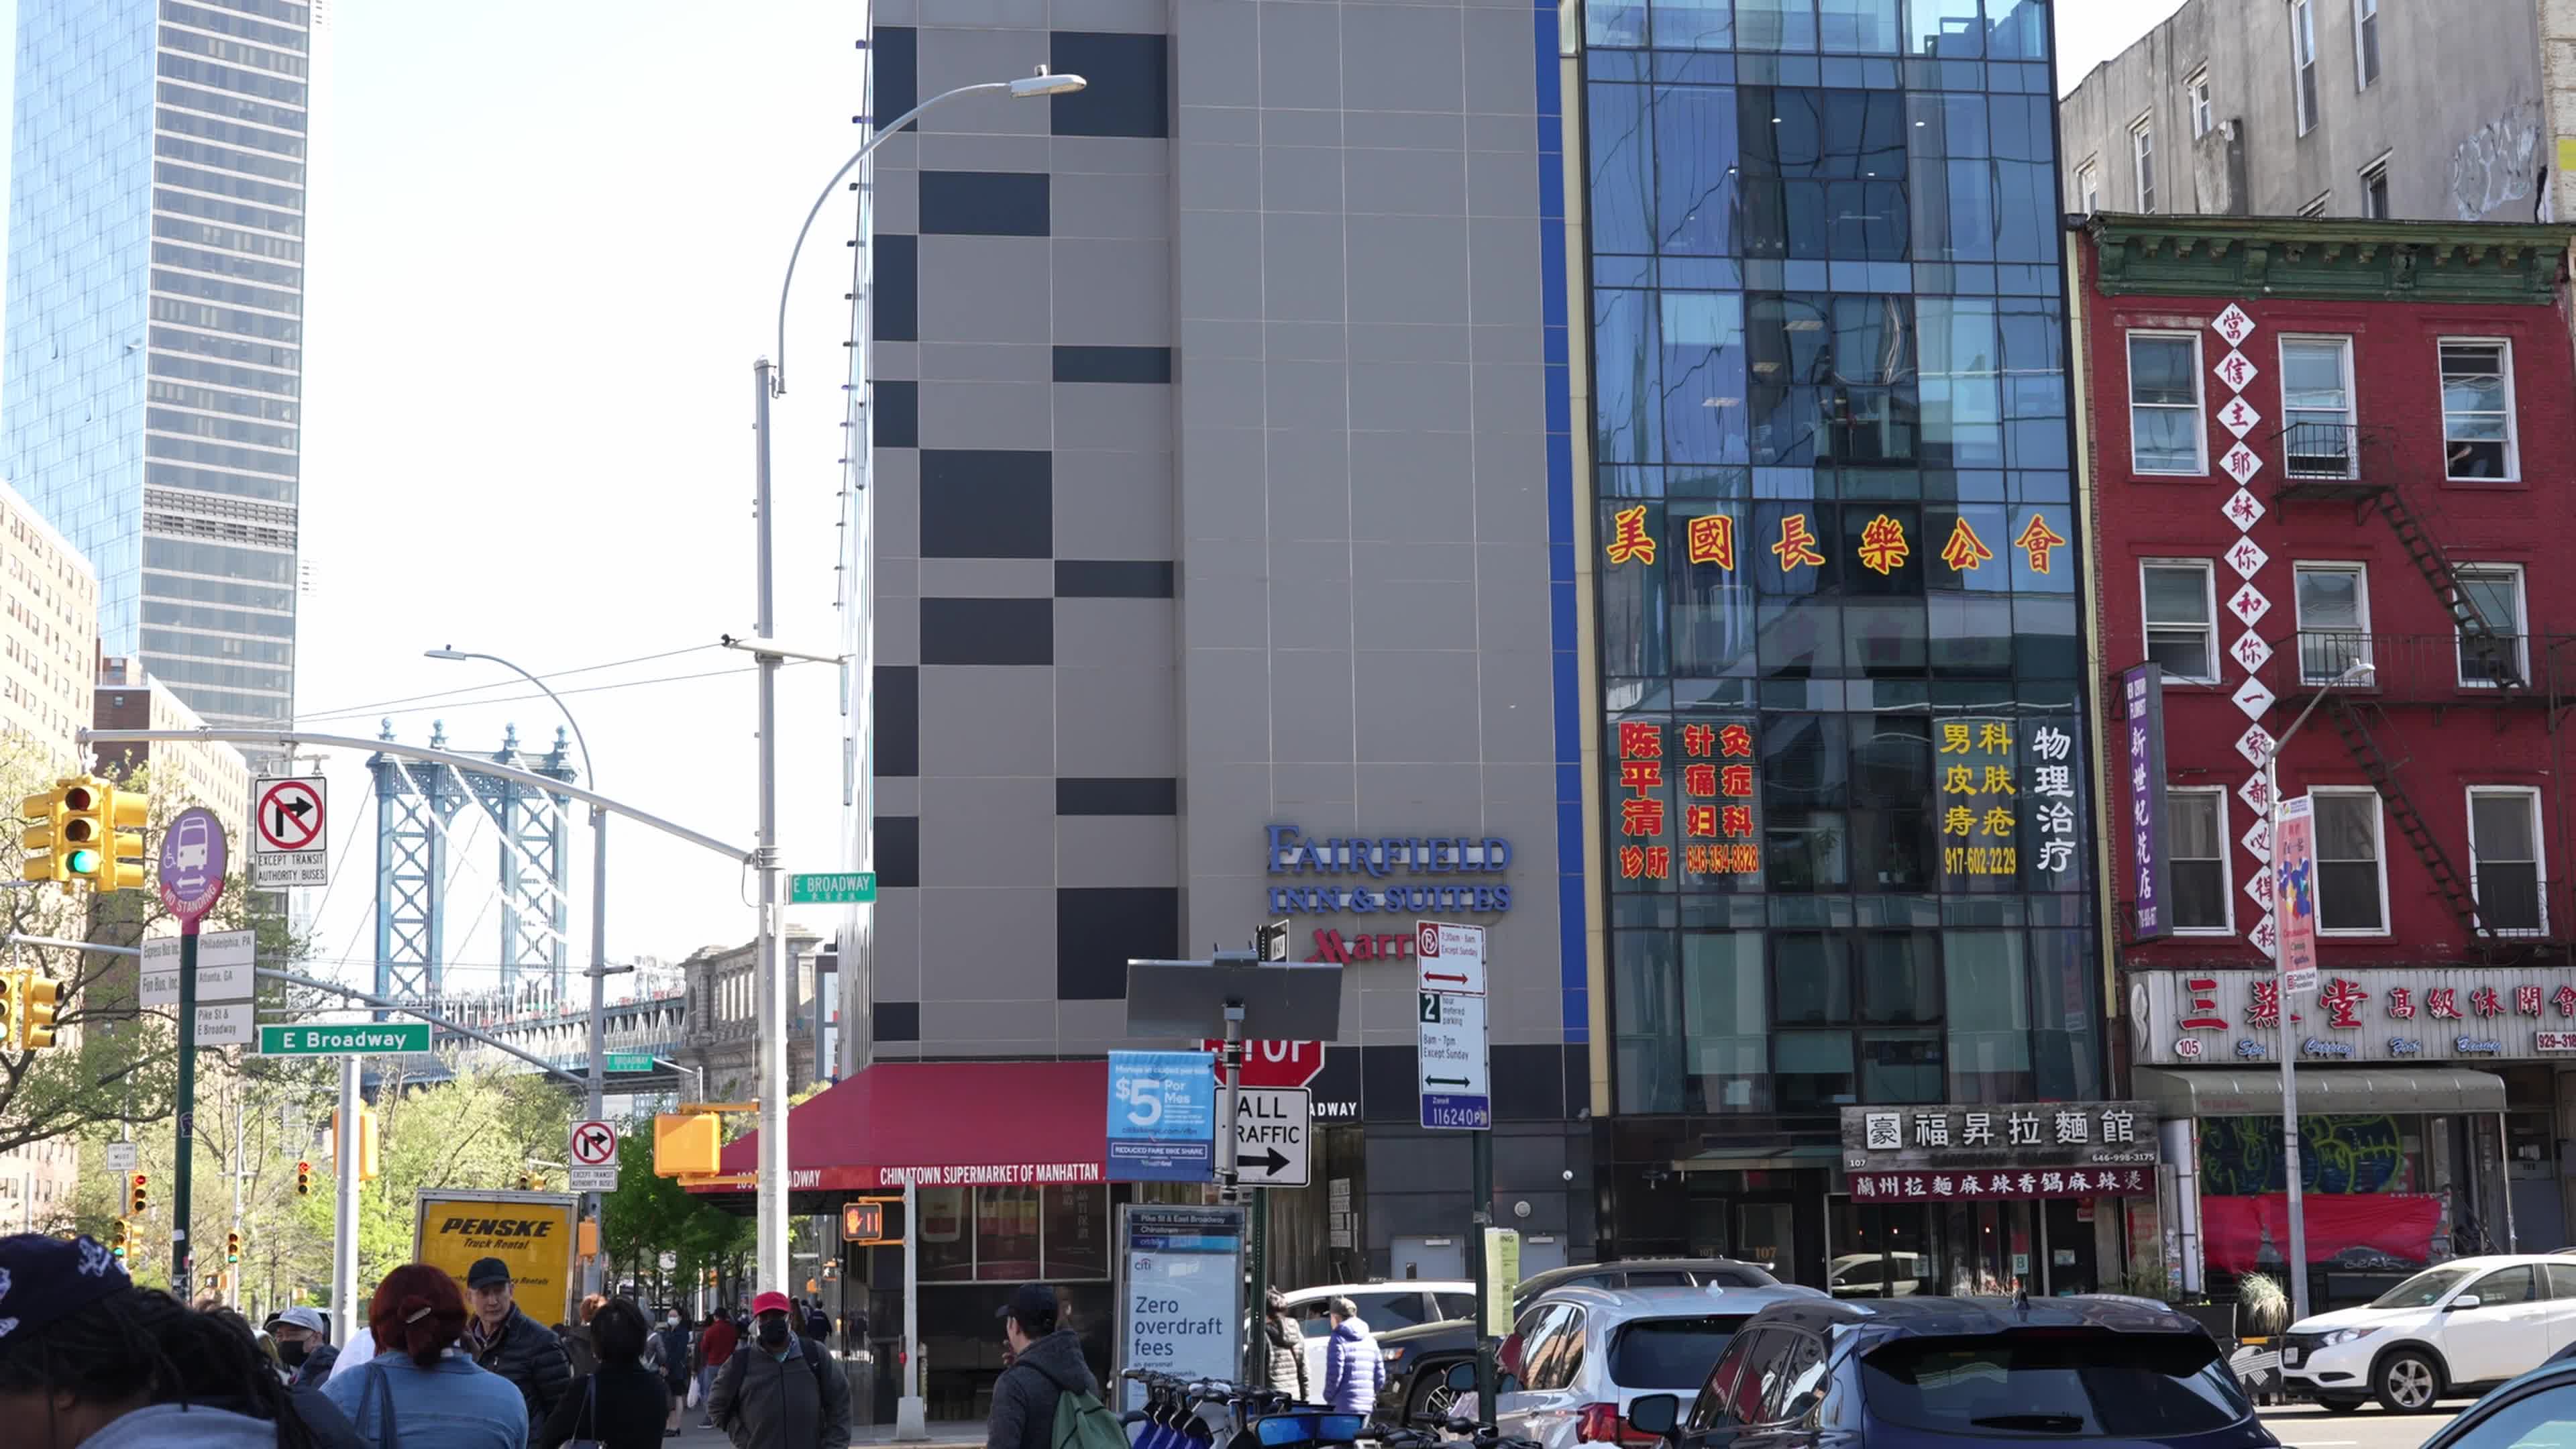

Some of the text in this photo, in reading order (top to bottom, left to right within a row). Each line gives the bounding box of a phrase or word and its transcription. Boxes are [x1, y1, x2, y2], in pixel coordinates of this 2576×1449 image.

[1606, 505, 2065, 575] 美國長樂公會
[1684, 724, 1752, 757] 针灸
[1940, 722, 2013, 755] 男科
[1685, 763, 1754, 796] 痛症
[1943, 763, 2017, 796] 皮肤
[2032, 726, 2076, 873] 物理治疗
[1686, 804, 1754, 837] 妇科
[258, 853, 323, 866] EXCEPT TRANSIT
[1620, 845, 1670, 879] 诊所
[1686, 844, 1760, 873] 646-354-8828
[1945, 847, 2017, 875] 917-602-2229
[258, 869, 325, 881] AUTHORITY BUSES
[794, 875, 870, 893] E BROADWAY
[164, 883, 217, 913] NO STANDING
[1267, 885, 1513, 914] INN & SUITES
[242, 935, 252, 946] PA
[199, 1010, 213, 1021] Pike
[214, 1008, 222, 1020] St
[1424, 994, 1436, 1020] 2
[198, 1024, 237, 1036] E Broadway
[283, 1031, 407, 1051] E Broadway
[1443, 1035, 1456, 1046] 7pm
[2179, 1041, 2198, 1055] 105
[1424, 1047, 1469, 1063] Except Sunday
[1164, 1080, 1186, 1091] Por
[1116, 1077, 1163, 1126] $5
[1164, 1093, 1191, 1104] Mes
[1238, 1096, 1287, 1118] ALL
[1434, 1108, 1473, 1126] 116240
[1238, 1126, 1300, 1144] RAFFIC
[1148, 1146, 1164, 1155] FARE
[1849, 1153, 2155, 1167] 107 646-998-3175
[880, 1163, 1099, 1185] CHINATOWN SUPERMARKET OF MANHATTAN
[440, 1218, 555, 1238] PENSKE
[866, 1212, 879, 1233] 11
[1190, 1216, 1226, 1224] Broadway
[1140, 1226, 1179, 1234] Chinatown
[464, 1238, 530, 1250] Truck Rental
[1755, 1245, 1777, 1260] 107
[1134, 1259, 1152, 1271] citi
[1135, 1295, 1179, 1313] Zero
[1134, 1318, 1223, 1335] overdraft
[1134, 1338, 1174, 1356] fees
